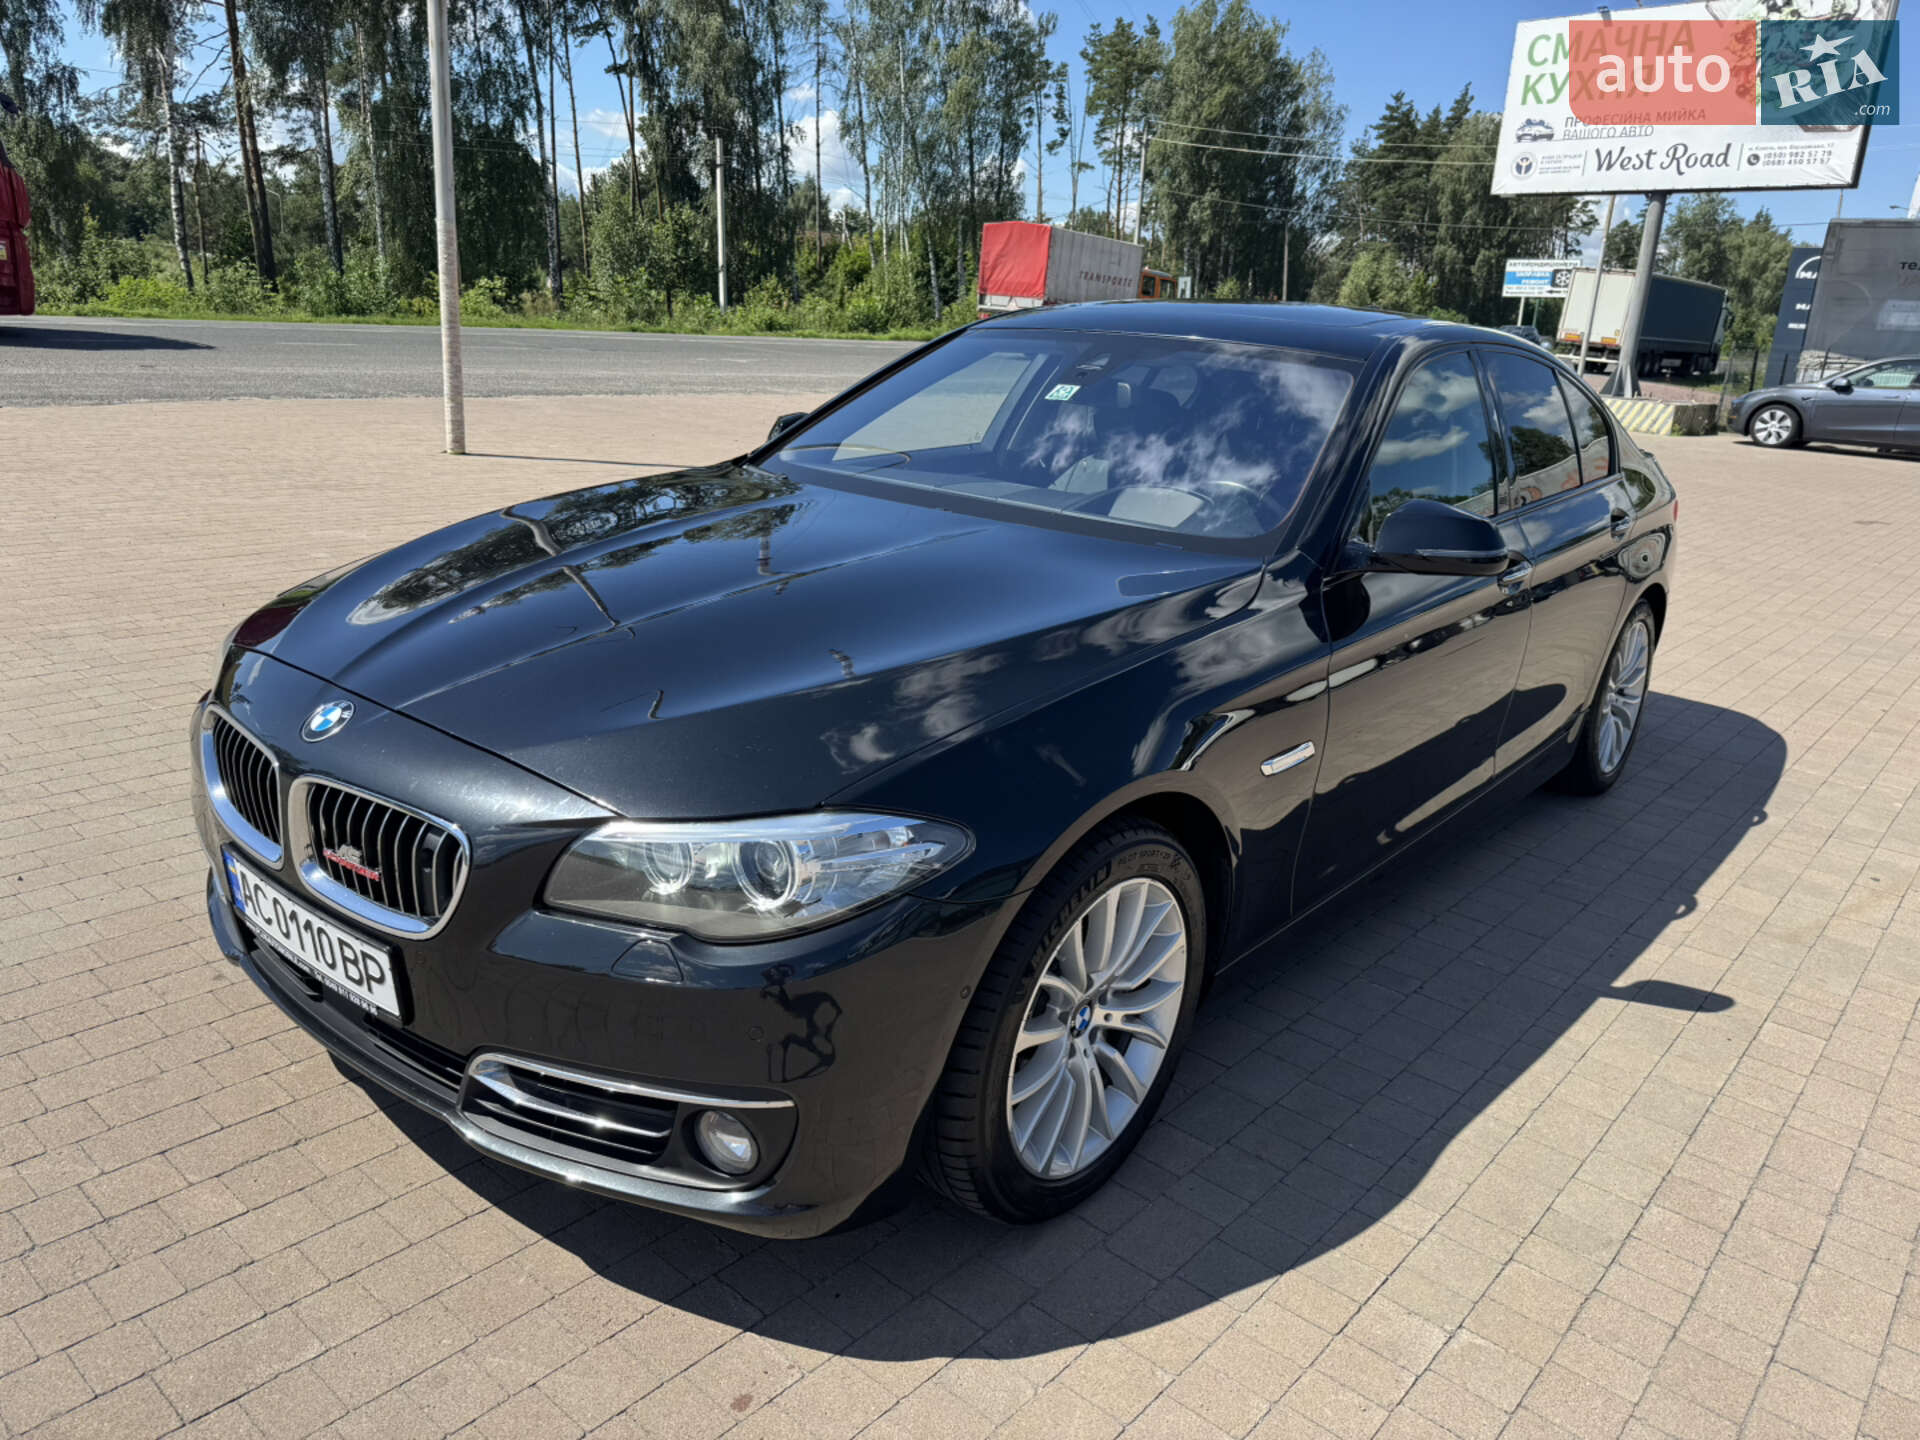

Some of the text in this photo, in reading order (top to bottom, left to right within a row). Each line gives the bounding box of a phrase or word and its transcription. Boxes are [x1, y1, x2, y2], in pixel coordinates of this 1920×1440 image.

[1619, 124, 1655, 138] АВТО
[1595, 142, 1732, 176] West Road
[1030, 859, 1113, 969] MICHELIN
